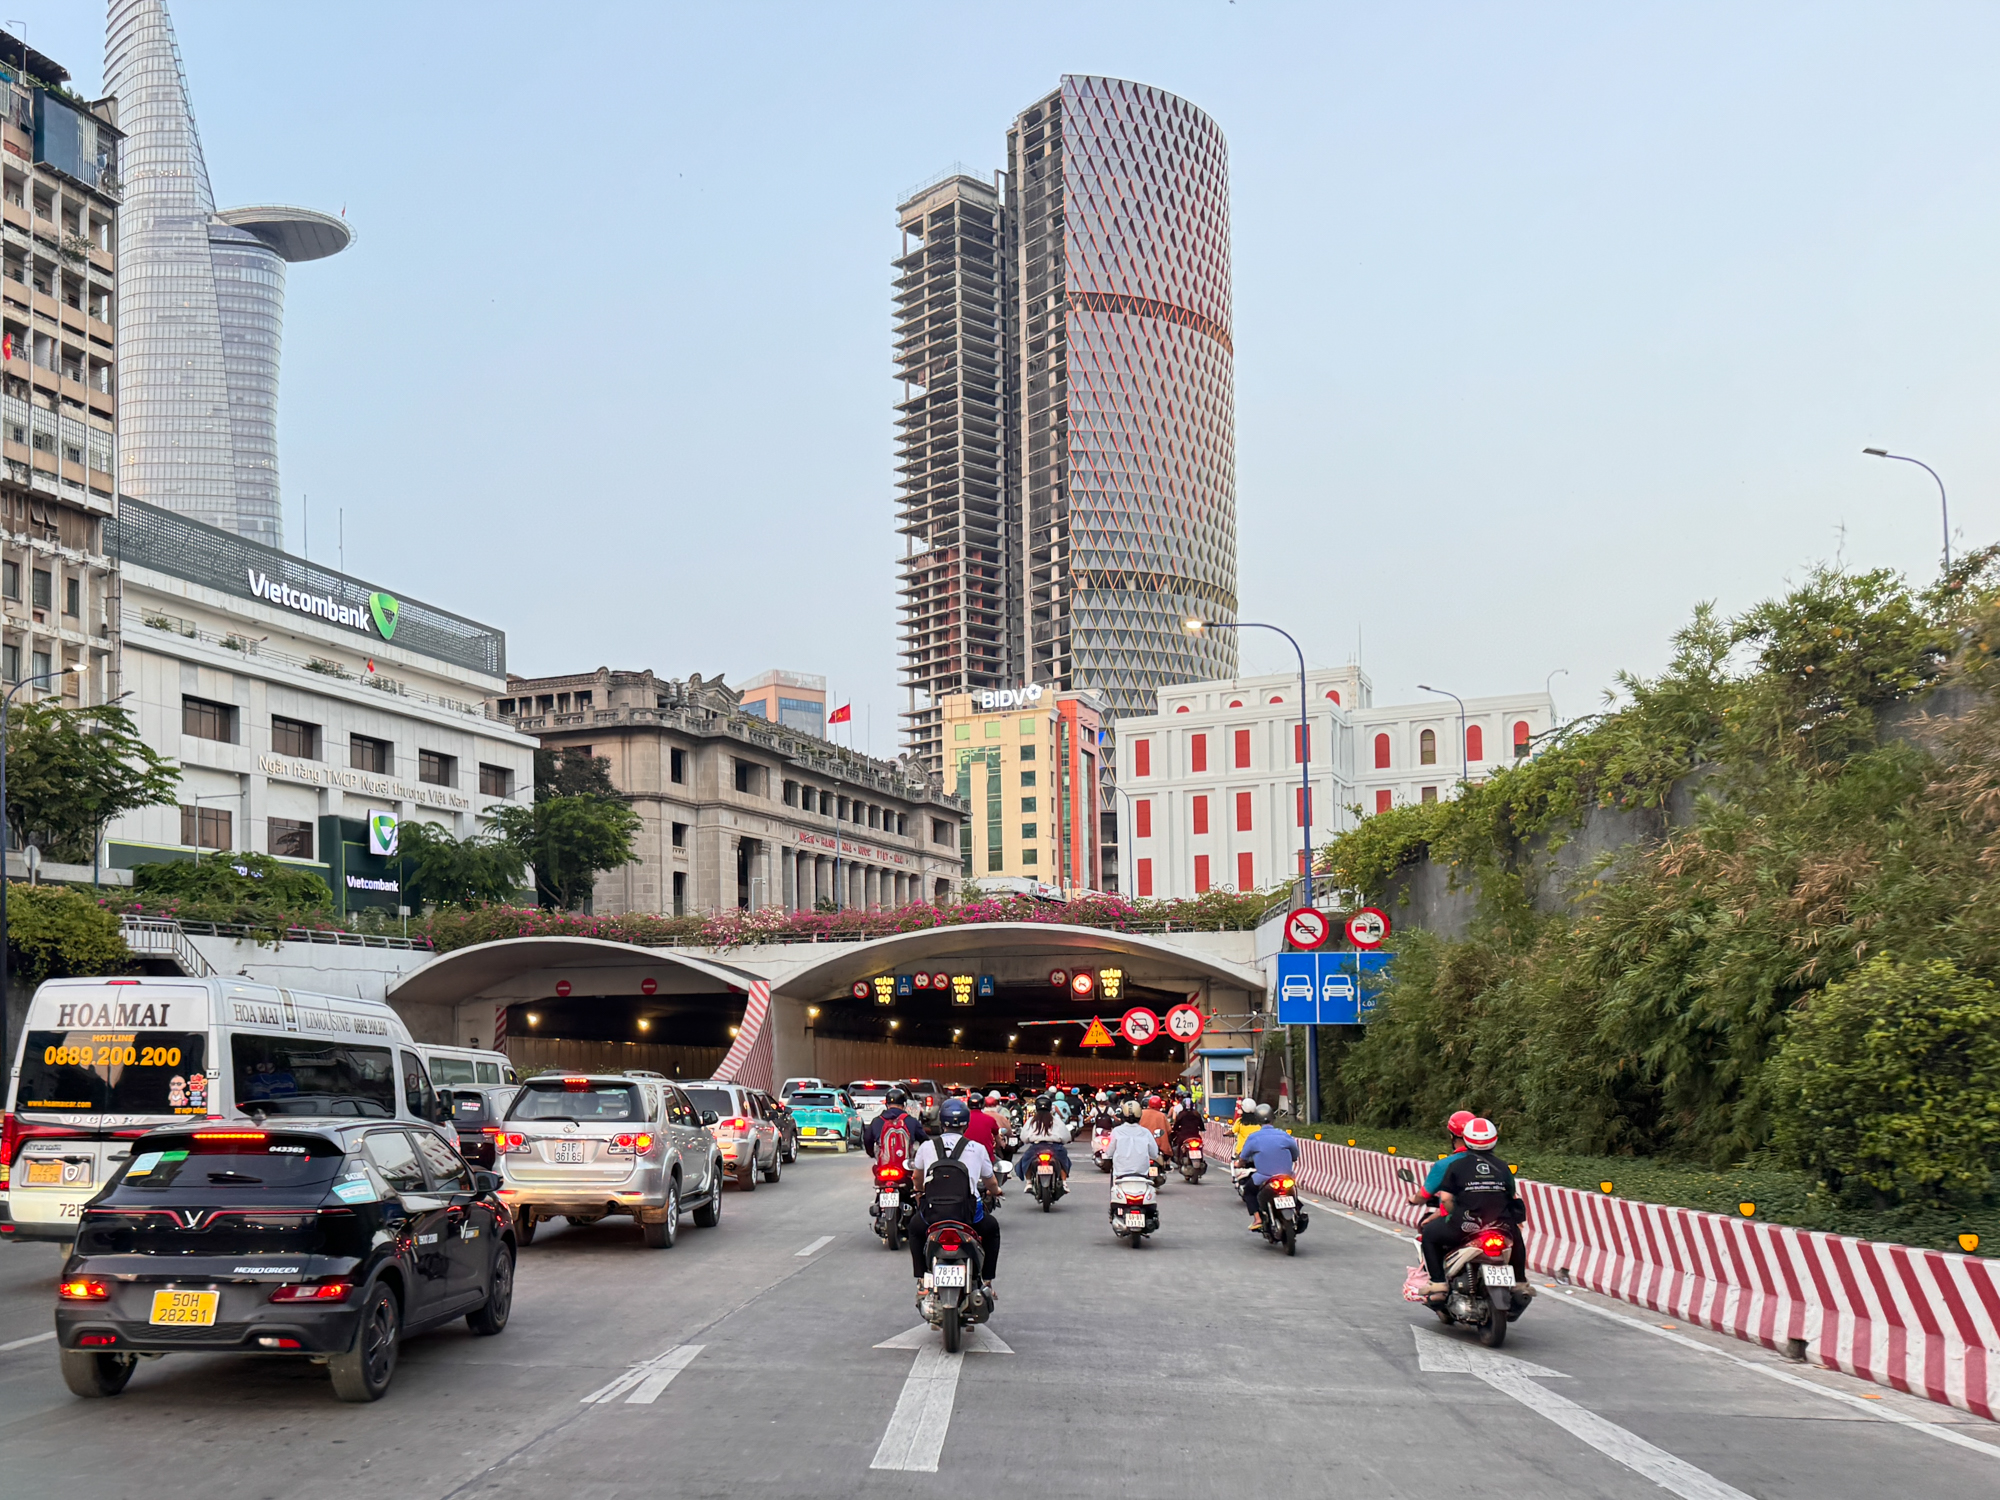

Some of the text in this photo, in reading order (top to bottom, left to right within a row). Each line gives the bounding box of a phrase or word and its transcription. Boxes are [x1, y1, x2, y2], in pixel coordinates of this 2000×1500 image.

[248, 568, 370, 632] Vietcombank
[982, 688, 1027, 709] BIDV
[258, 754, 289, 775] Ngân
[293, 762, 320, 784] hàng
[323, 769, 358, 787] TMCP
[361, 776, 389, 796] Ngoại
[428, 789, 446, 806] Việt
[449, 794, 470, 809] Nam
[346, 875, 399, 893] Vietcombank
[57, 1003, 170, 1028] HOA MAI
[233, 1004, 280, 1026] HOA MAI
[304, 1011, 351, 1033] LIMOUSINE
[1175, 1017, 1194, 1029] 2.2m
[92, 1034, 136, 1043] HOTLINE
[44, 1046, 182, 1067] 0889.200.200
[68, 1115, 134, 1124] DCAR
[561, 1142, 577, 1152] 51F
[233, 1266, 263, 1274] HERIO
[938, 1266, 960, 1276] 78-F1
[1487, 1266, 1508, 1276] 59-C1
[172, 1293, 200, 1307] 50H
[158, 1309, 207, 1323] 282.91
